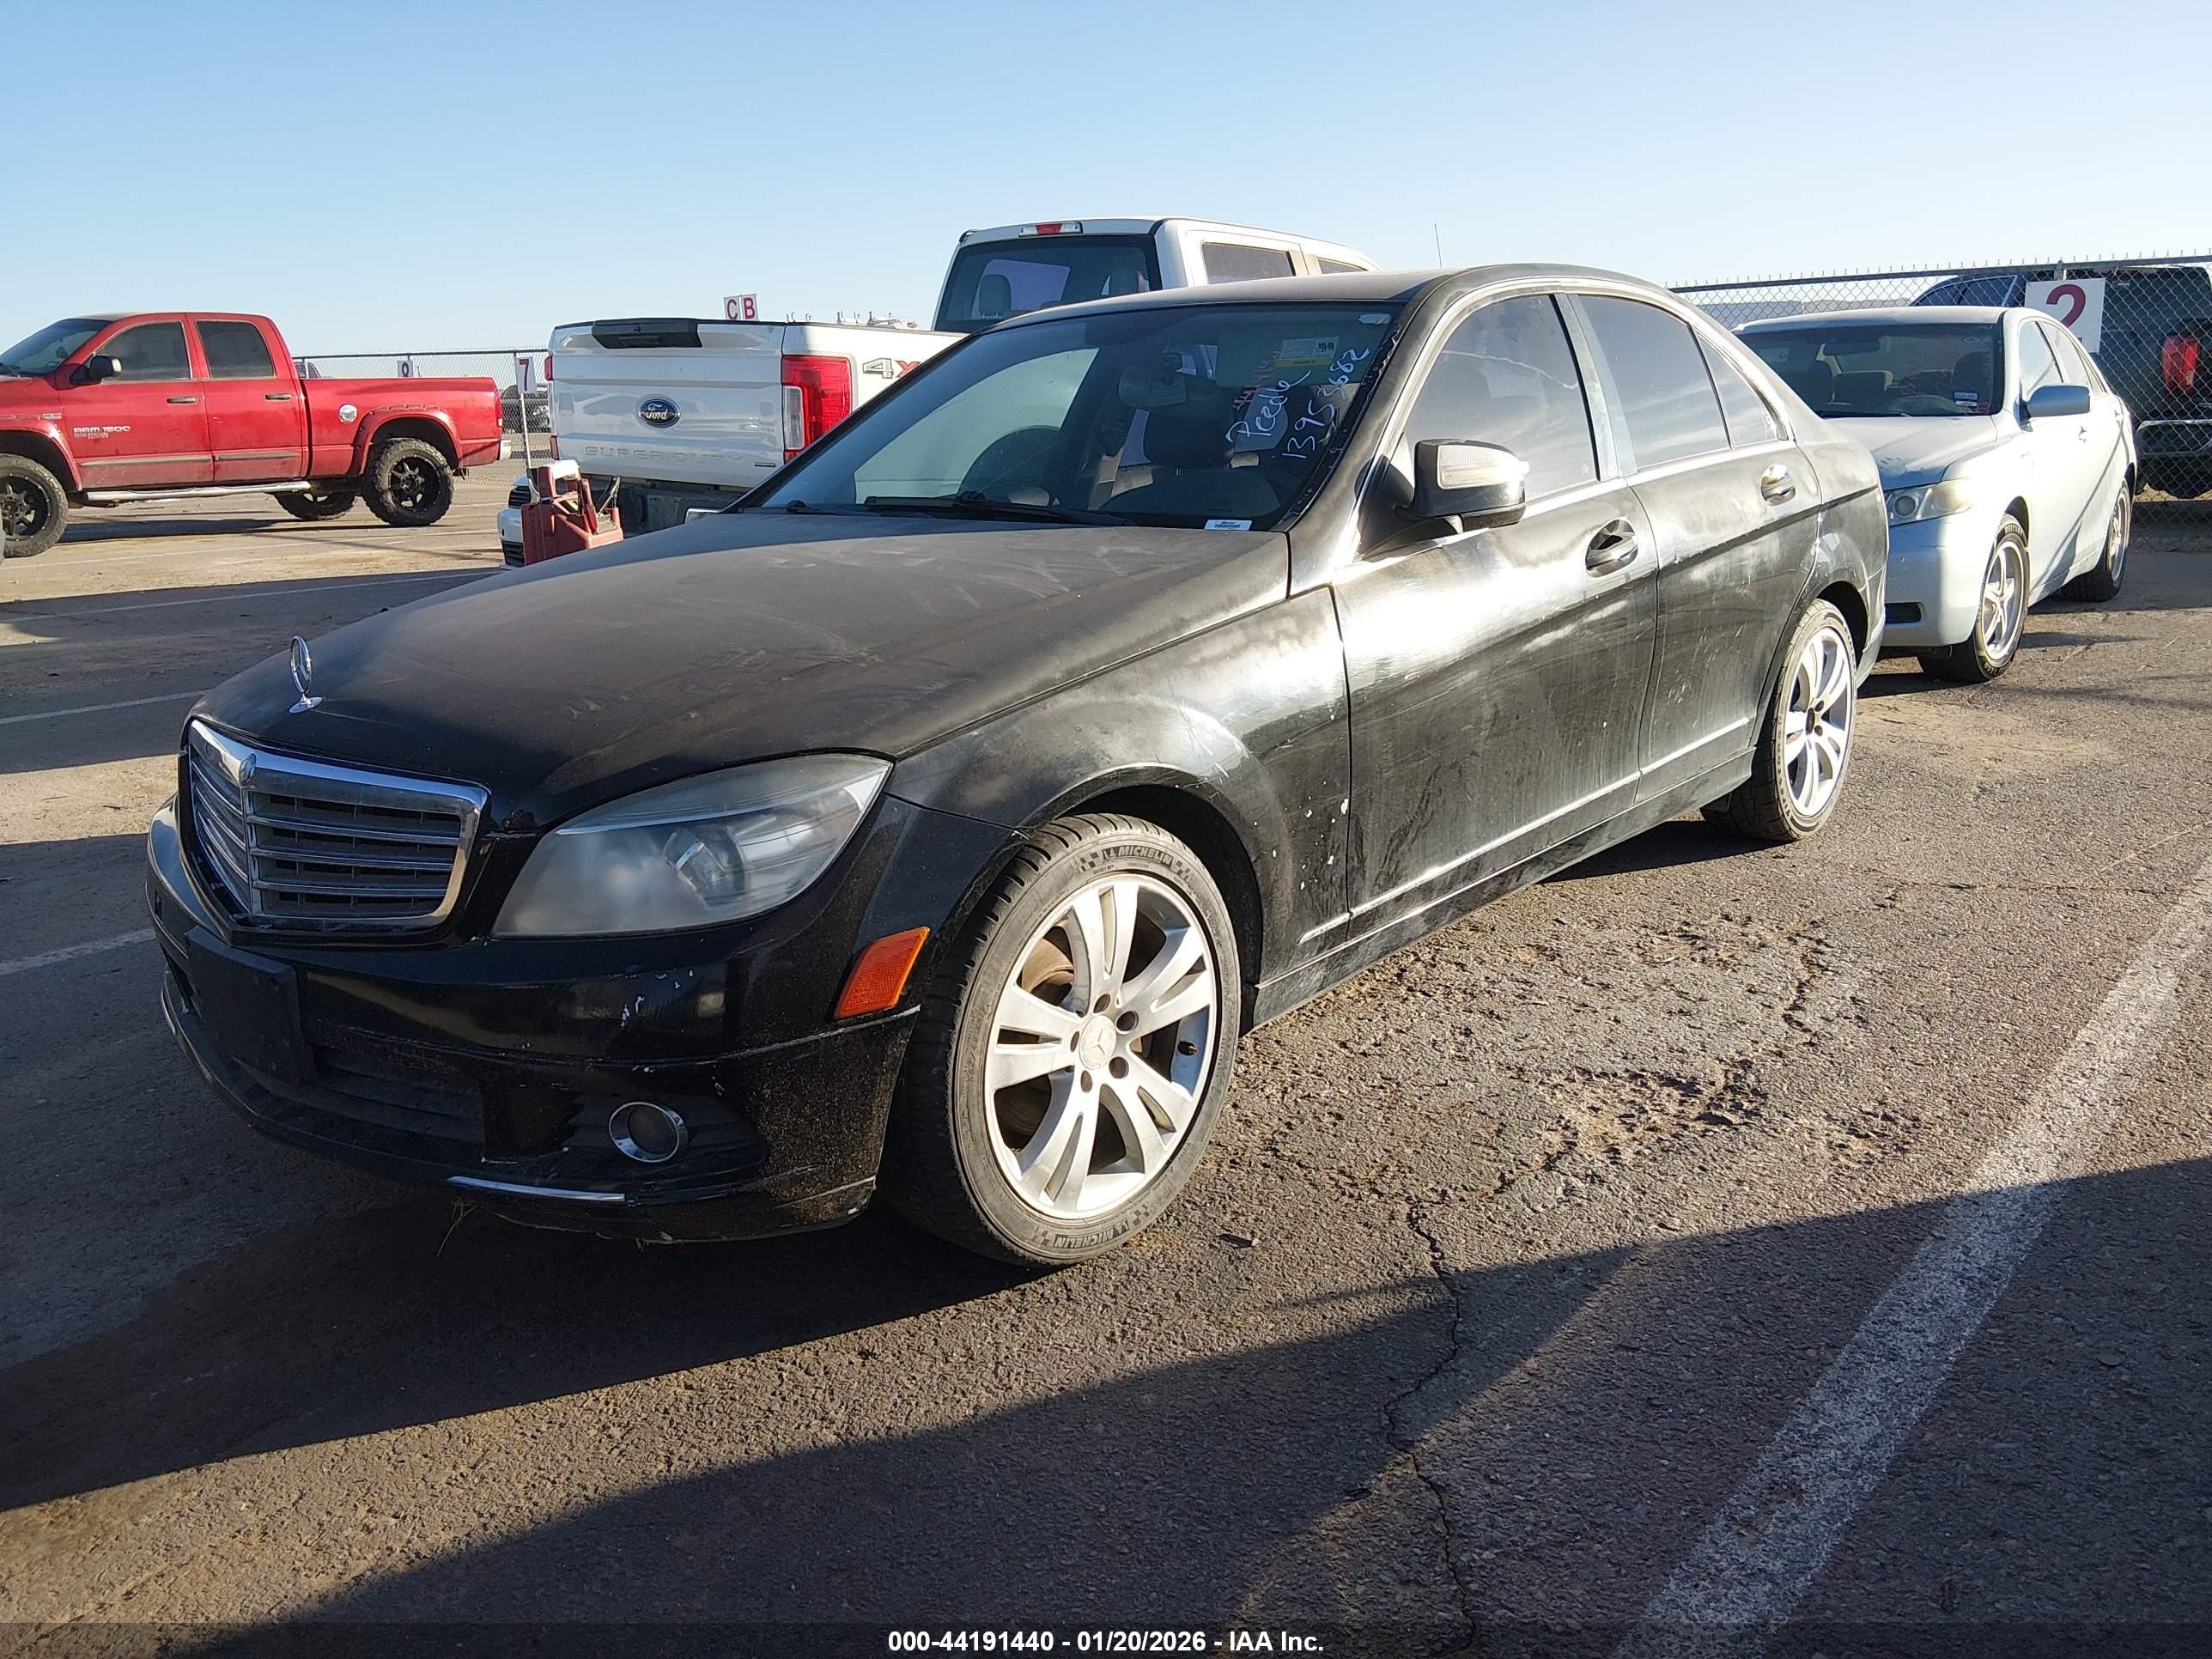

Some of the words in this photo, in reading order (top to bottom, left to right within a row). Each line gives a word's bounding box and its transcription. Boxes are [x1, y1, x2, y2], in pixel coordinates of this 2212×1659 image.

[726, 298, 738, 320] C
[743, 297, 756, 319] B
[519, 358, 530, 392] 7
[645, 403, 669, 421] Ford
[102, 424, 131, 433] 1500
[584, 446, 664, 461] SUPER
[672, 451, 744, 465] DUTY
[1117, 846, 1173, 867] MICHELIN
[1054, 1225, 1115, 1249] MICHELIN
